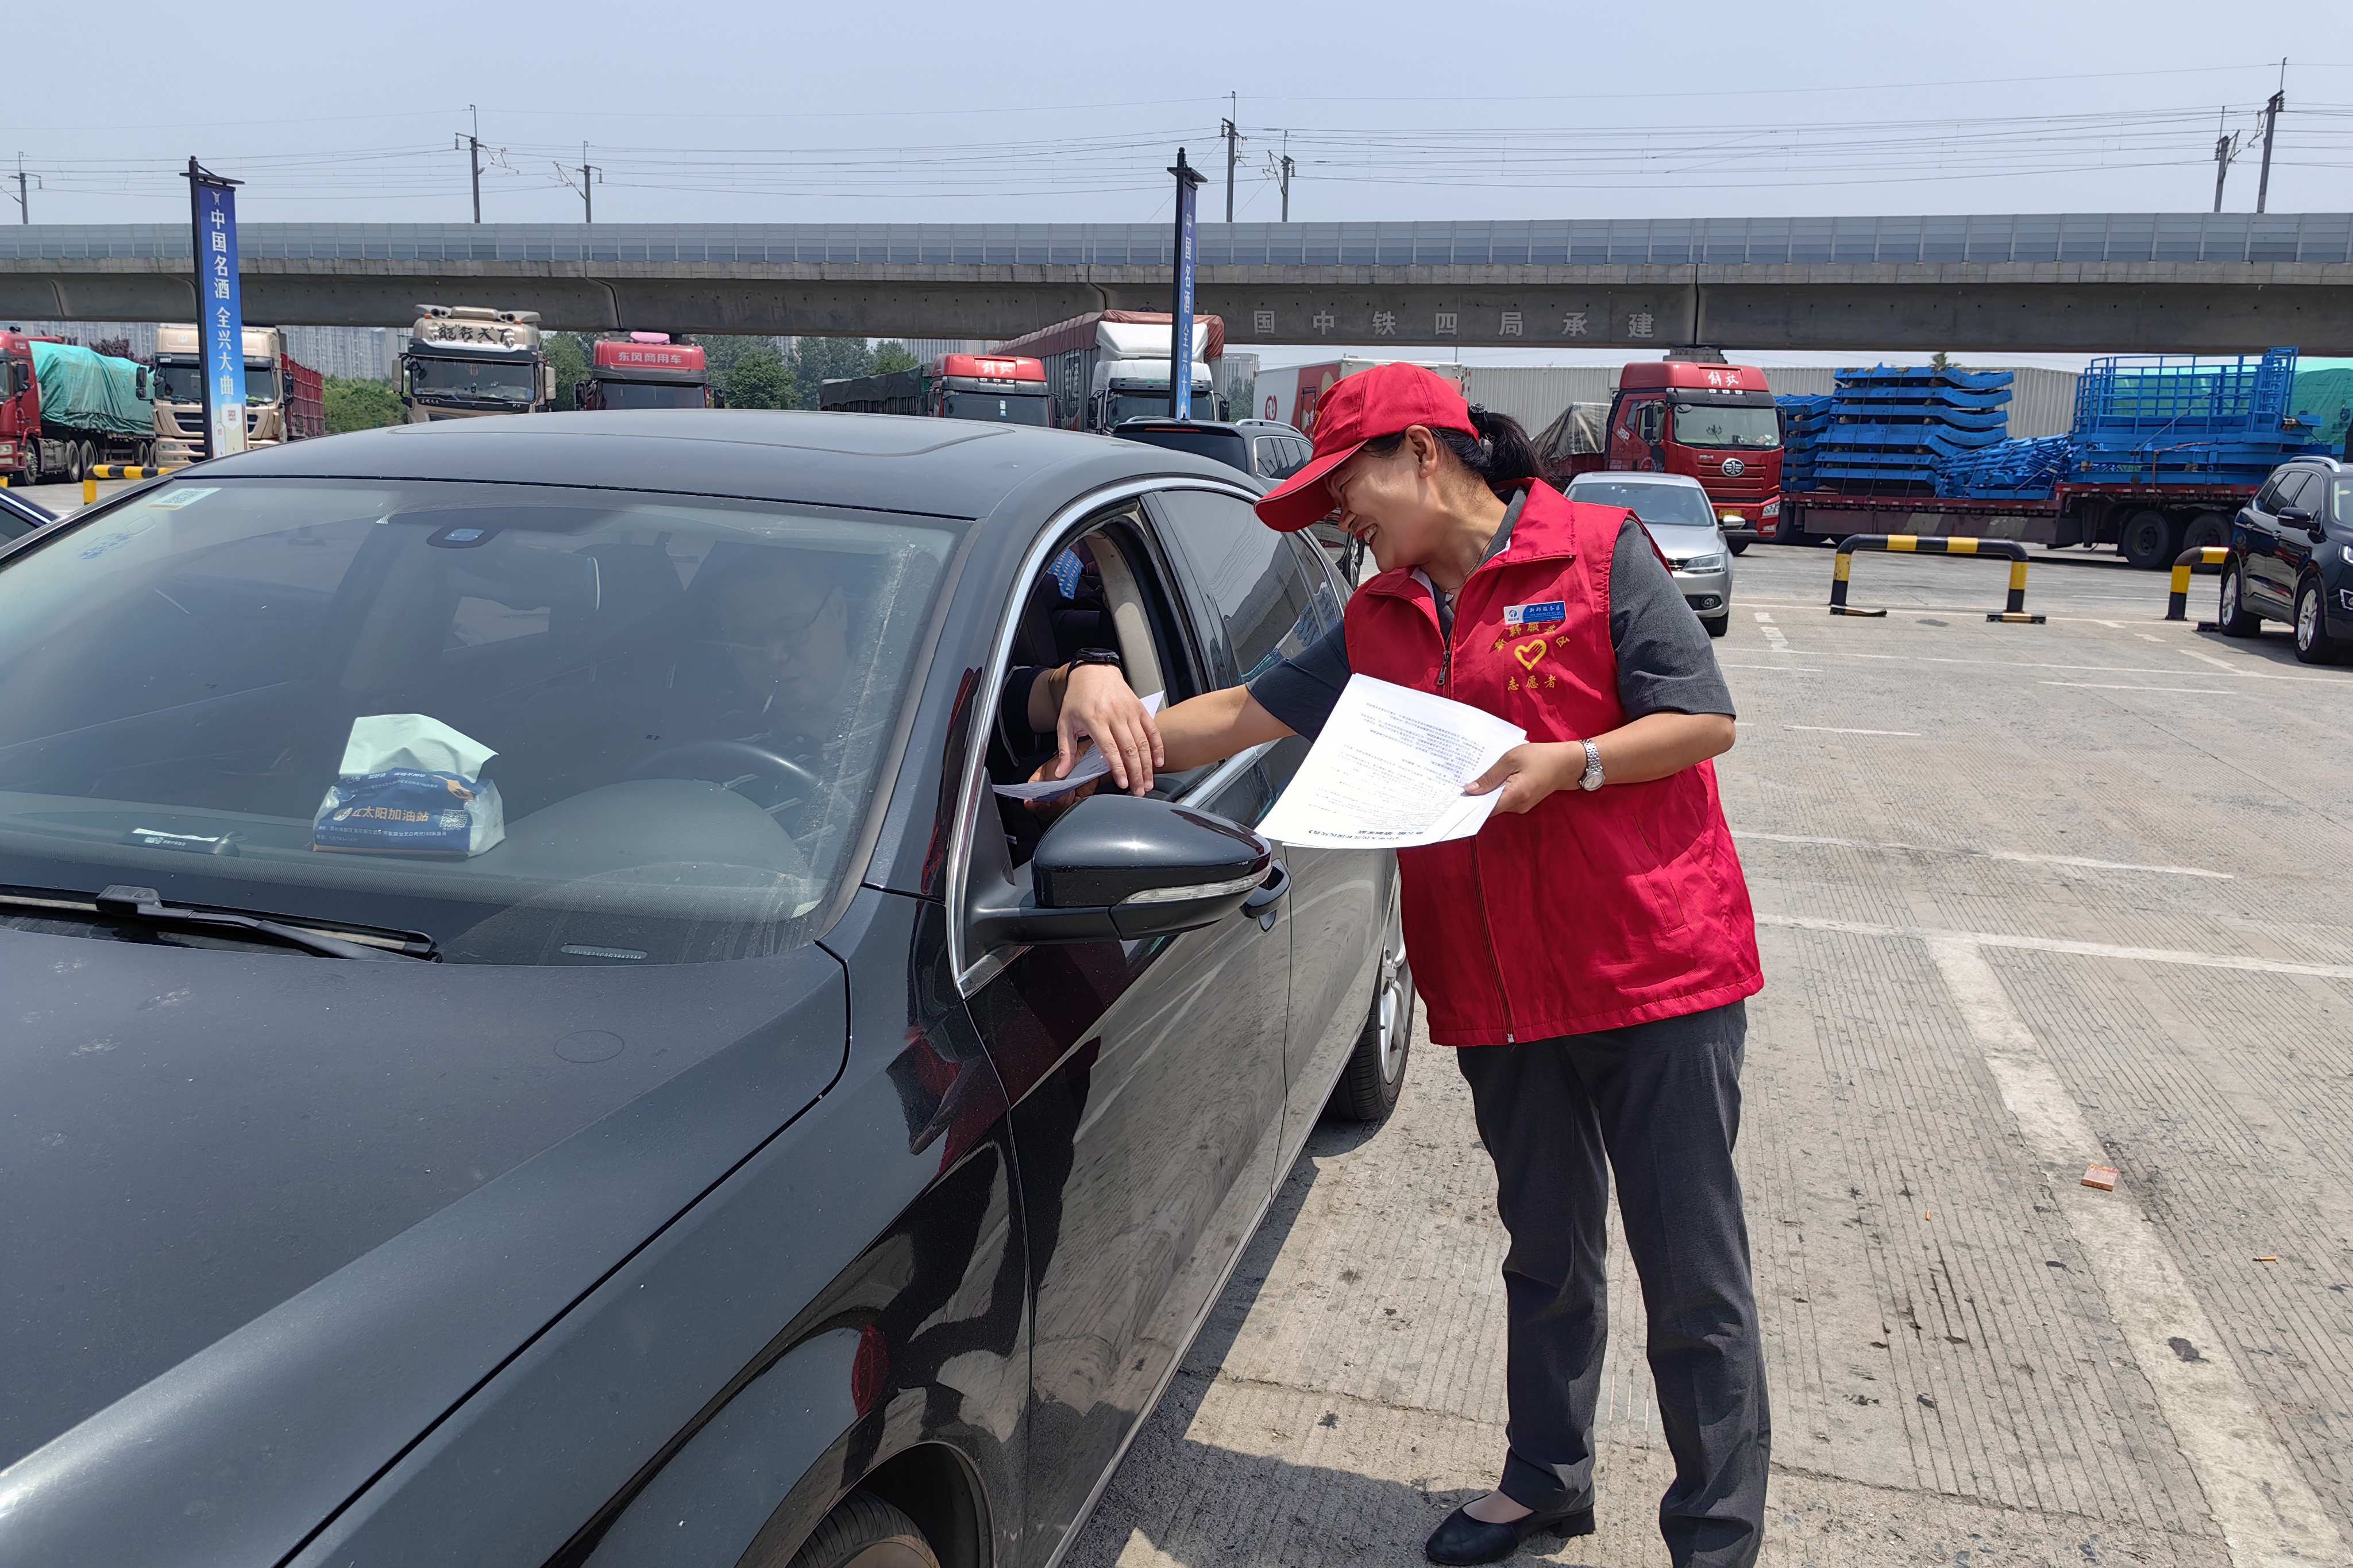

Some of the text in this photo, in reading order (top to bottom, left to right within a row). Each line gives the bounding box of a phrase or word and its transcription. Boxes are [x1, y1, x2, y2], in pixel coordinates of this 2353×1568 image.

[211, 209, 230, 300] 中国名酒
[1183, 210, 1192, 315] 中国名酒
[1203, 310, 1654, 338] 国中铁四局承建
[216, 307, 234, 396] 全兴大曲
[618, 352, 682, 364] 东风商用车
[1708, 370, 1739, 387] 解放
[1507, 674, 1557, 691] 志愿者
